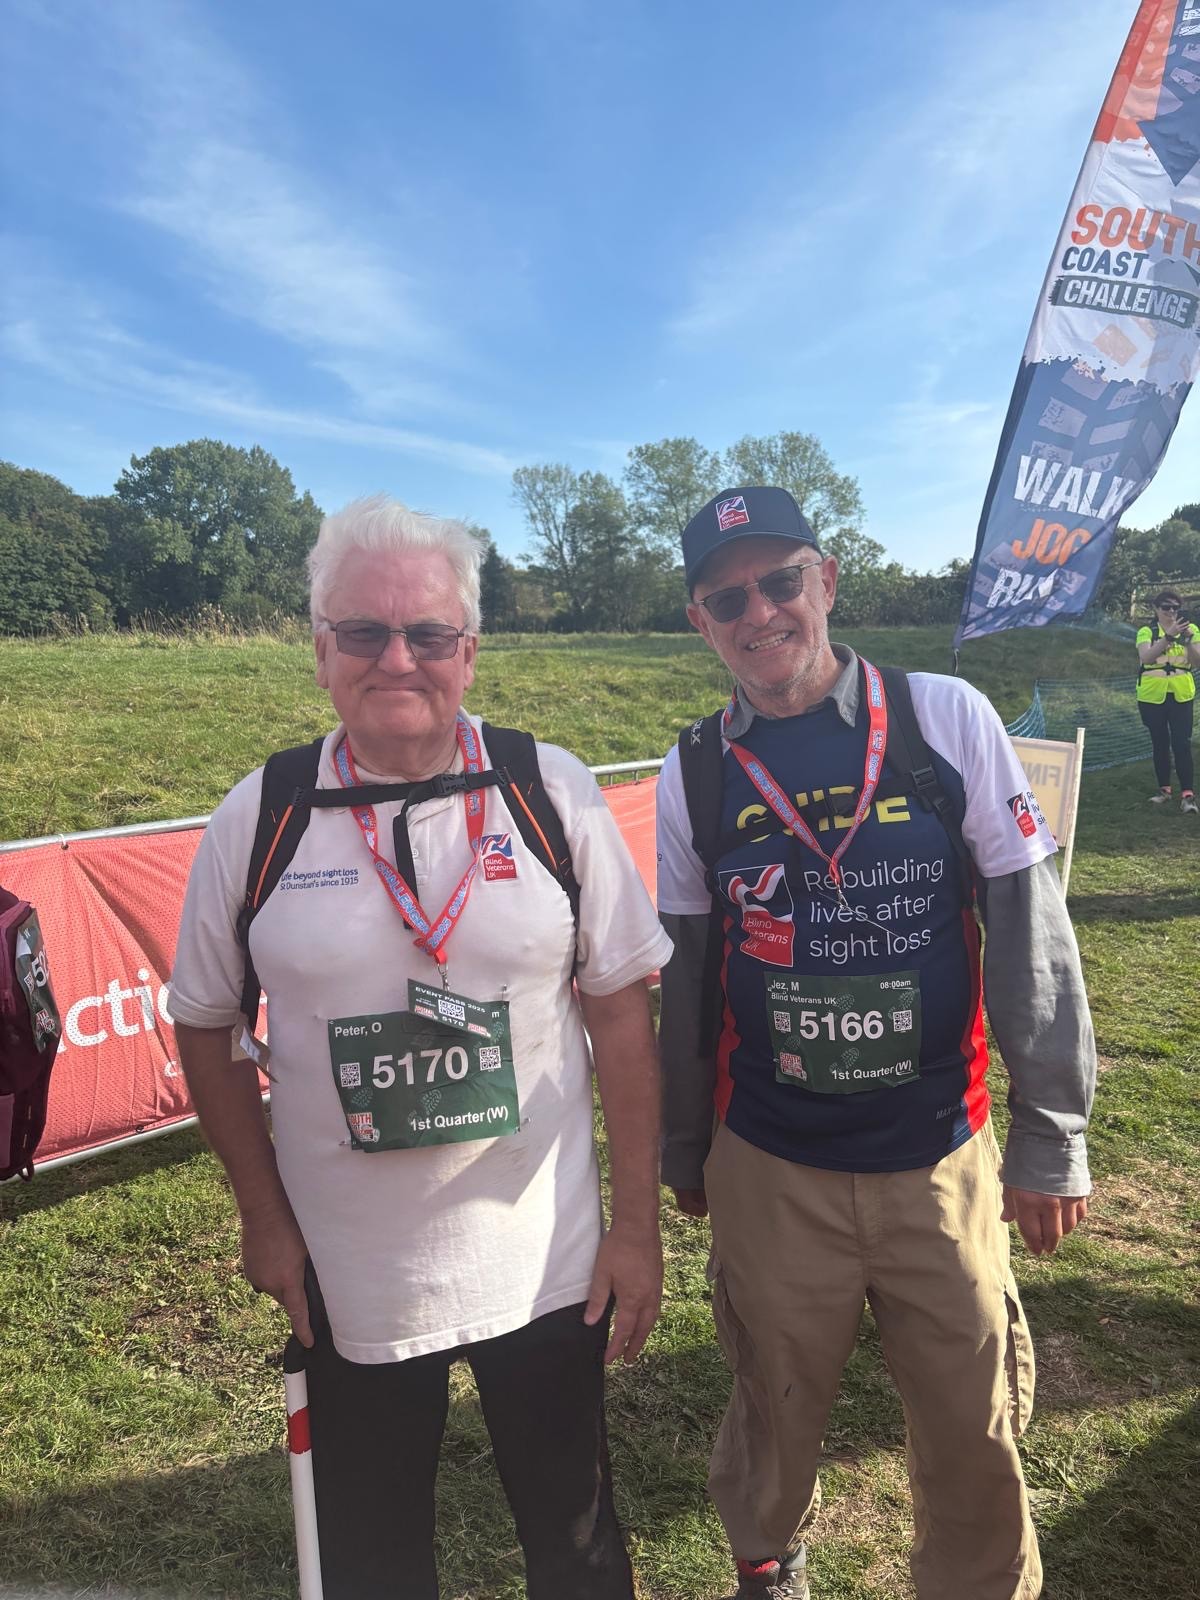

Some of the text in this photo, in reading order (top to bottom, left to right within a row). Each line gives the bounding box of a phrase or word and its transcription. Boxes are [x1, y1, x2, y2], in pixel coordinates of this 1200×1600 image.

[1071, 204, 1200, 266] SOUTH
[1062, 247, 1149, 278] COAST
[1064, 279, 1190, 324] CHALLENGE
[293, 871, 321, 881] beyond
[322, 870, 342, 878] sight
[484, 858, 502, 866] Blind
[486, 864, 514, 872] Veterans
[804, 858, 944, 892] Rebuilding
[287, 880, 319, 890] Dunstan's
[341, 877, 358, 885] 1915
[810, 893, 935, 923] lives after
[429, 919, 452, 948] 2025
[809, 929, 931, 964] sight loss
[771, 980, 911, 991] Jez, M 08:00am
[771, 993, 788, 1001] Blind
[790, 995, 822, 1004] Veterans
[415, 986, 443, 999] EVENT
[467, 1004, 486, 1013] 2025
[335, 1022, 382, 1038] Peter, O
[800, 1011, 884, 1041] 5166
[372, 1046, 469, 1089] 5170
[832, 1060, 913, 1080] 1st Quarter (W)
[411, 1106, 509, 1131] 1st Quarter (W)
